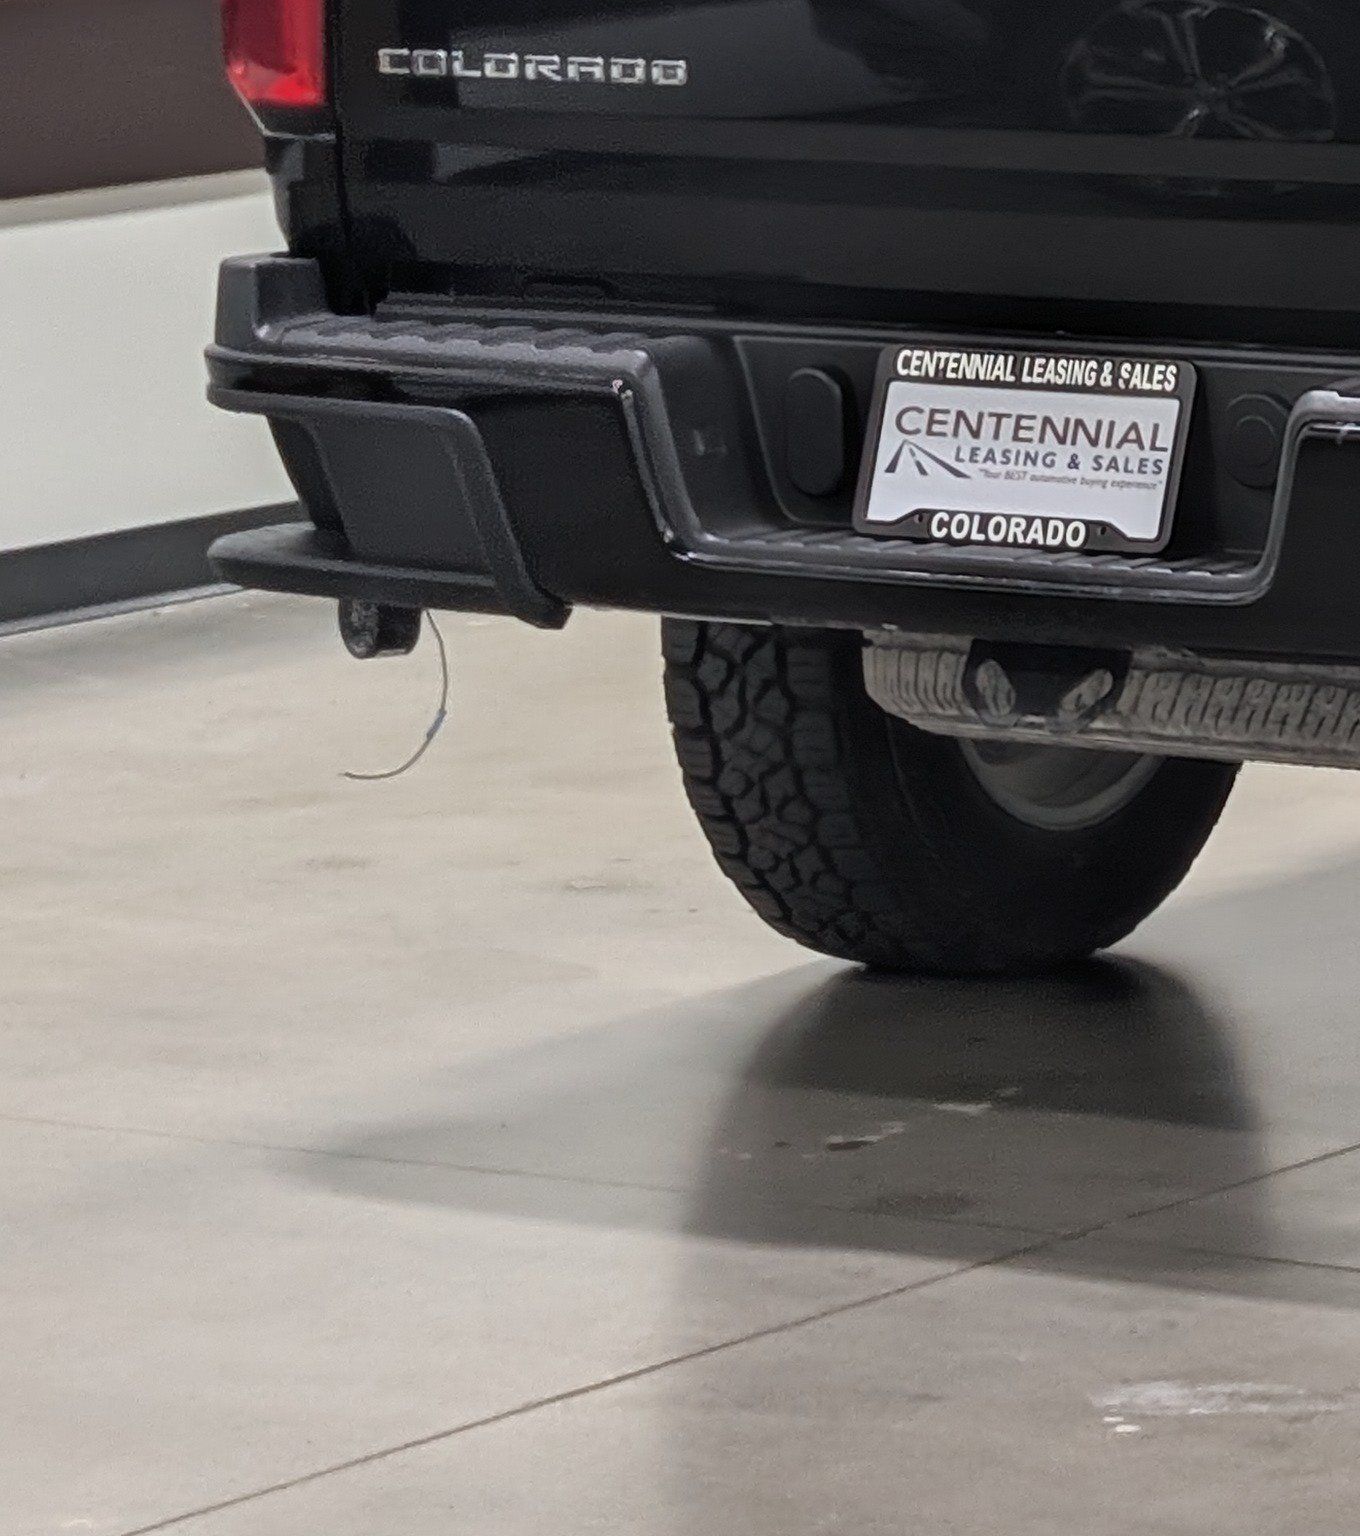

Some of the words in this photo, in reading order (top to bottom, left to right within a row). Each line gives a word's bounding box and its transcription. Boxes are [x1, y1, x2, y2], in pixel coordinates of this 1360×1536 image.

[377, 47, 688, 87] COLORADO
[896, 349, 1015, 382] CENTENNIAL
[1021, 357, 1097, 387] LEASING
[1100, 361, 1113, 387] &
[1118, 363, 1178, 392] SALES
[895, 406, 1169, 452] CENTENNIAL
[954, 445, 1057, 468] LEASING
[1067, 453, 1081, 470] &
[1092, 455, 1164, 476] SALES
[930, 511, 1087, 548] COLORADO
